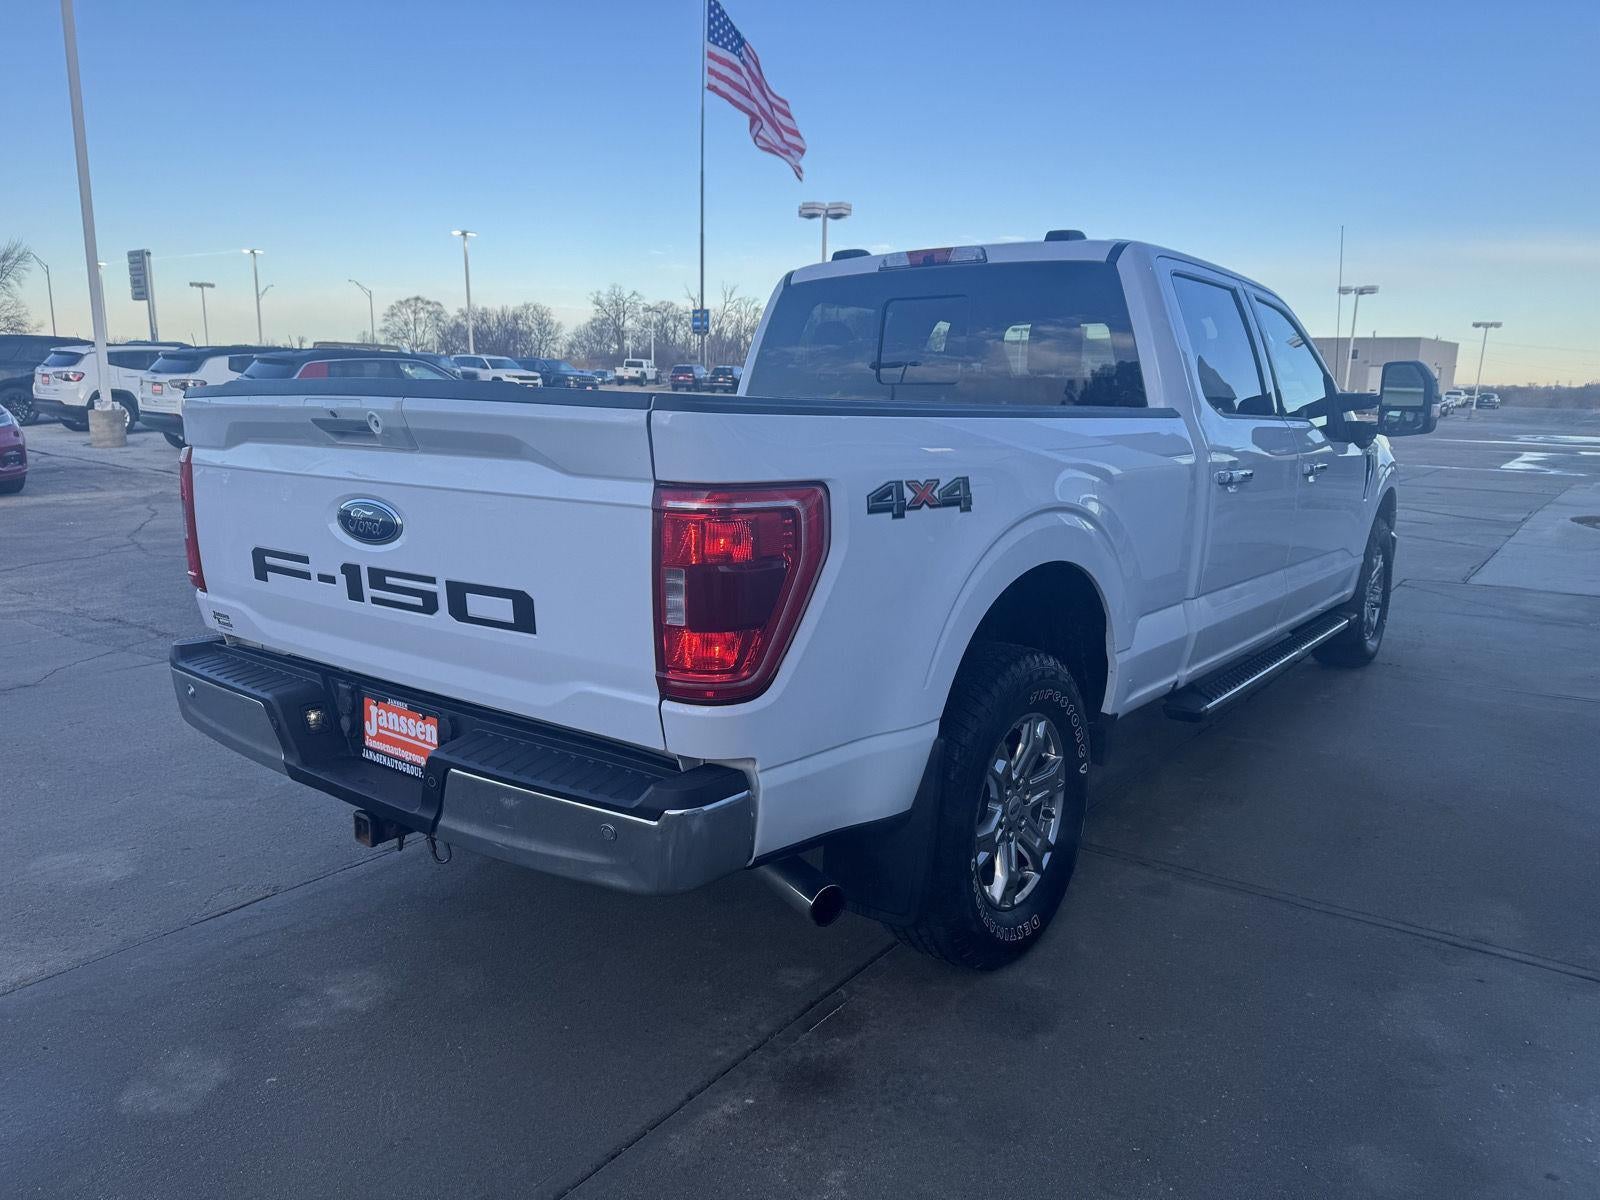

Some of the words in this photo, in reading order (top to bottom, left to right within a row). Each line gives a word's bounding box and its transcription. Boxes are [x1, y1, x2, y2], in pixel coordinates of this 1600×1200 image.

[349, 507, 383, 536] Ford
[251, 546, 537, 635] F-150
[365, 705, 438, 745] Janssen
